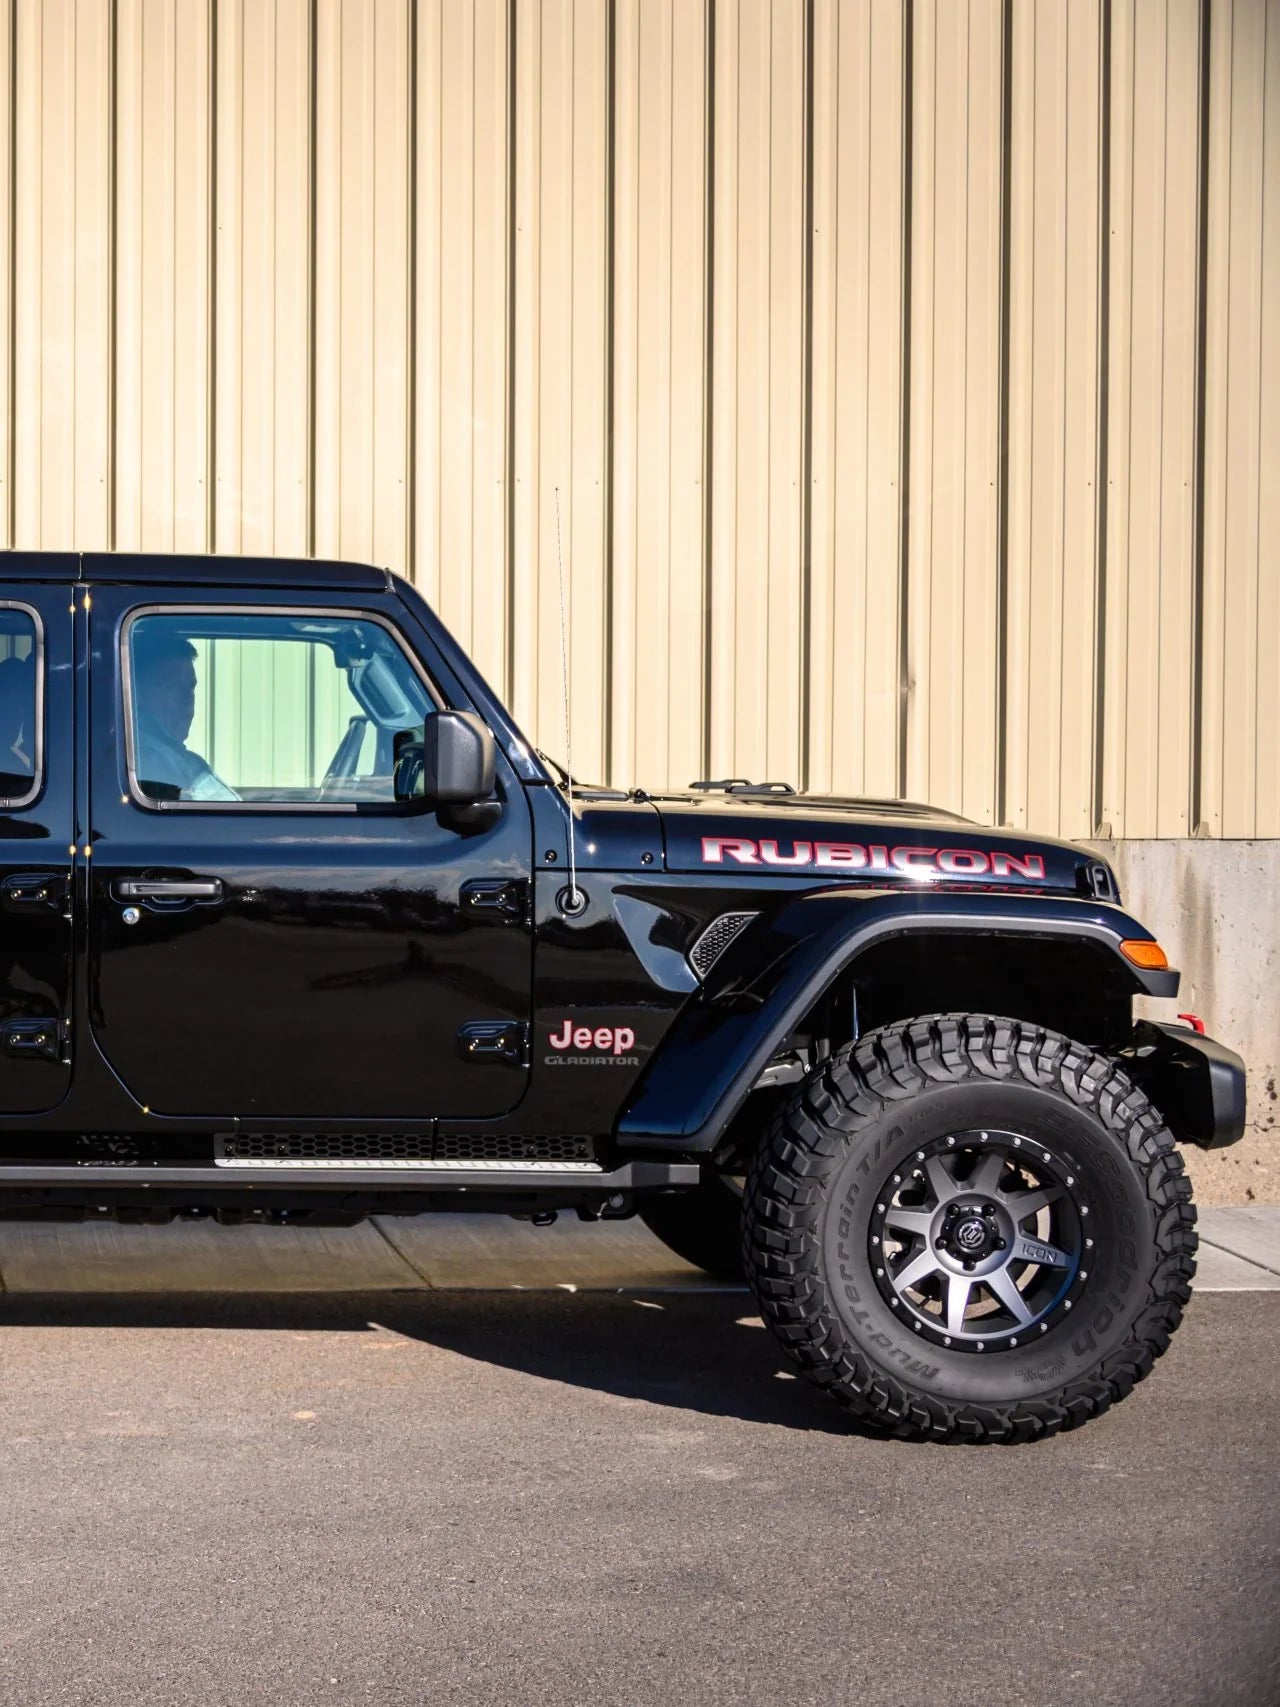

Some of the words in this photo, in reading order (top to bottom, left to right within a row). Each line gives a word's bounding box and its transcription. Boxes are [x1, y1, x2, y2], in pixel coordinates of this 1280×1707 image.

[701, 837, 1045, 879] RUBICON
[549, 1020, 635, 1055] Jeep
[544, 1056, 639, 1066] GLADIATOR
[1022, 1243, 1058, 1263] ICON
